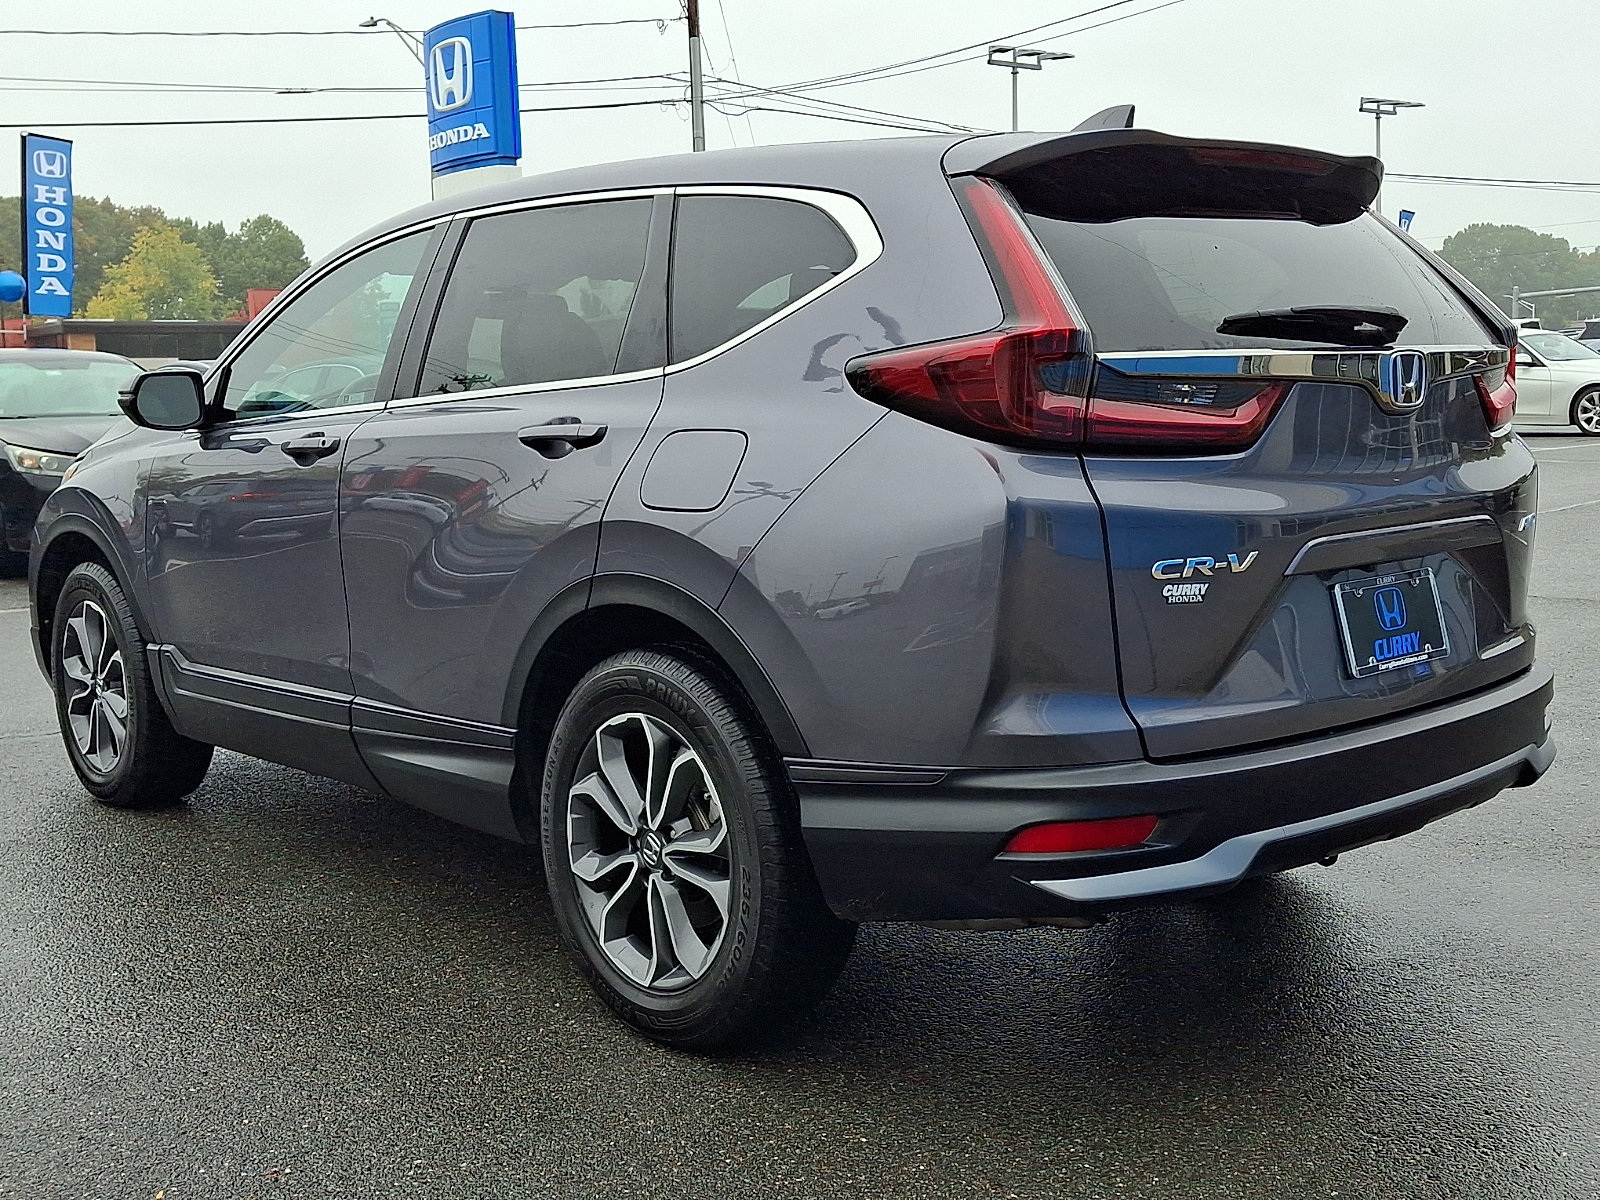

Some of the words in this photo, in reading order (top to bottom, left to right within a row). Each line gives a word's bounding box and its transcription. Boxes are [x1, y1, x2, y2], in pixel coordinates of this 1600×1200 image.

[429, 122, 490, 151] HONDA
[33, 184, 70, 296] HONDA
[1152, 551, 1259, 580] CR-V
[1163, 583, 1209, 598] CURRY
[1168, 595, 1203, 604] HONDA
[1374, 631, 1420, 660] CURRY
